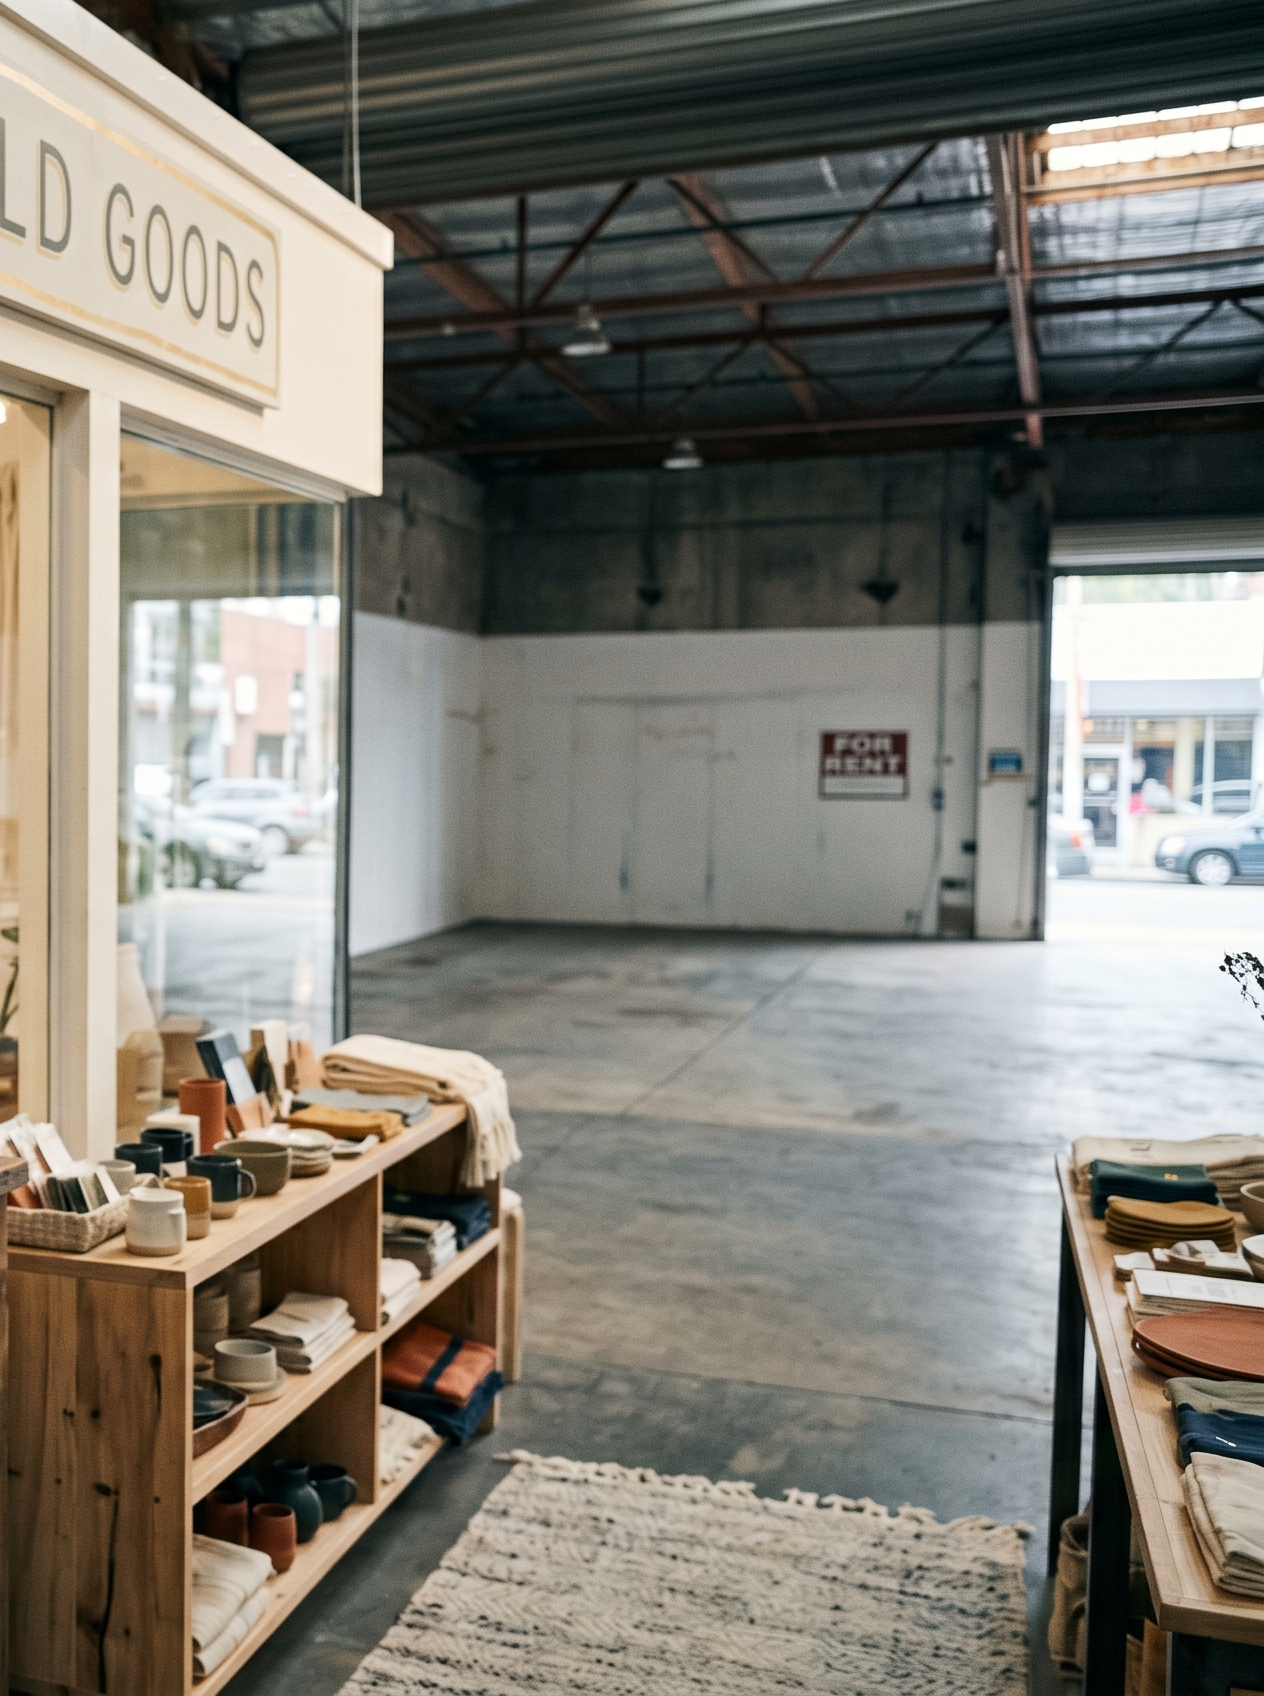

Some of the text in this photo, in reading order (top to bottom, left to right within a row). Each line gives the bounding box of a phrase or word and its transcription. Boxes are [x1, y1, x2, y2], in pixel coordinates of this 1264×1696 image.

[105, 183, 265, 349] GOODS
[833, 736, 892, 751] FOR
[824, 755, 901, 772] RENT
